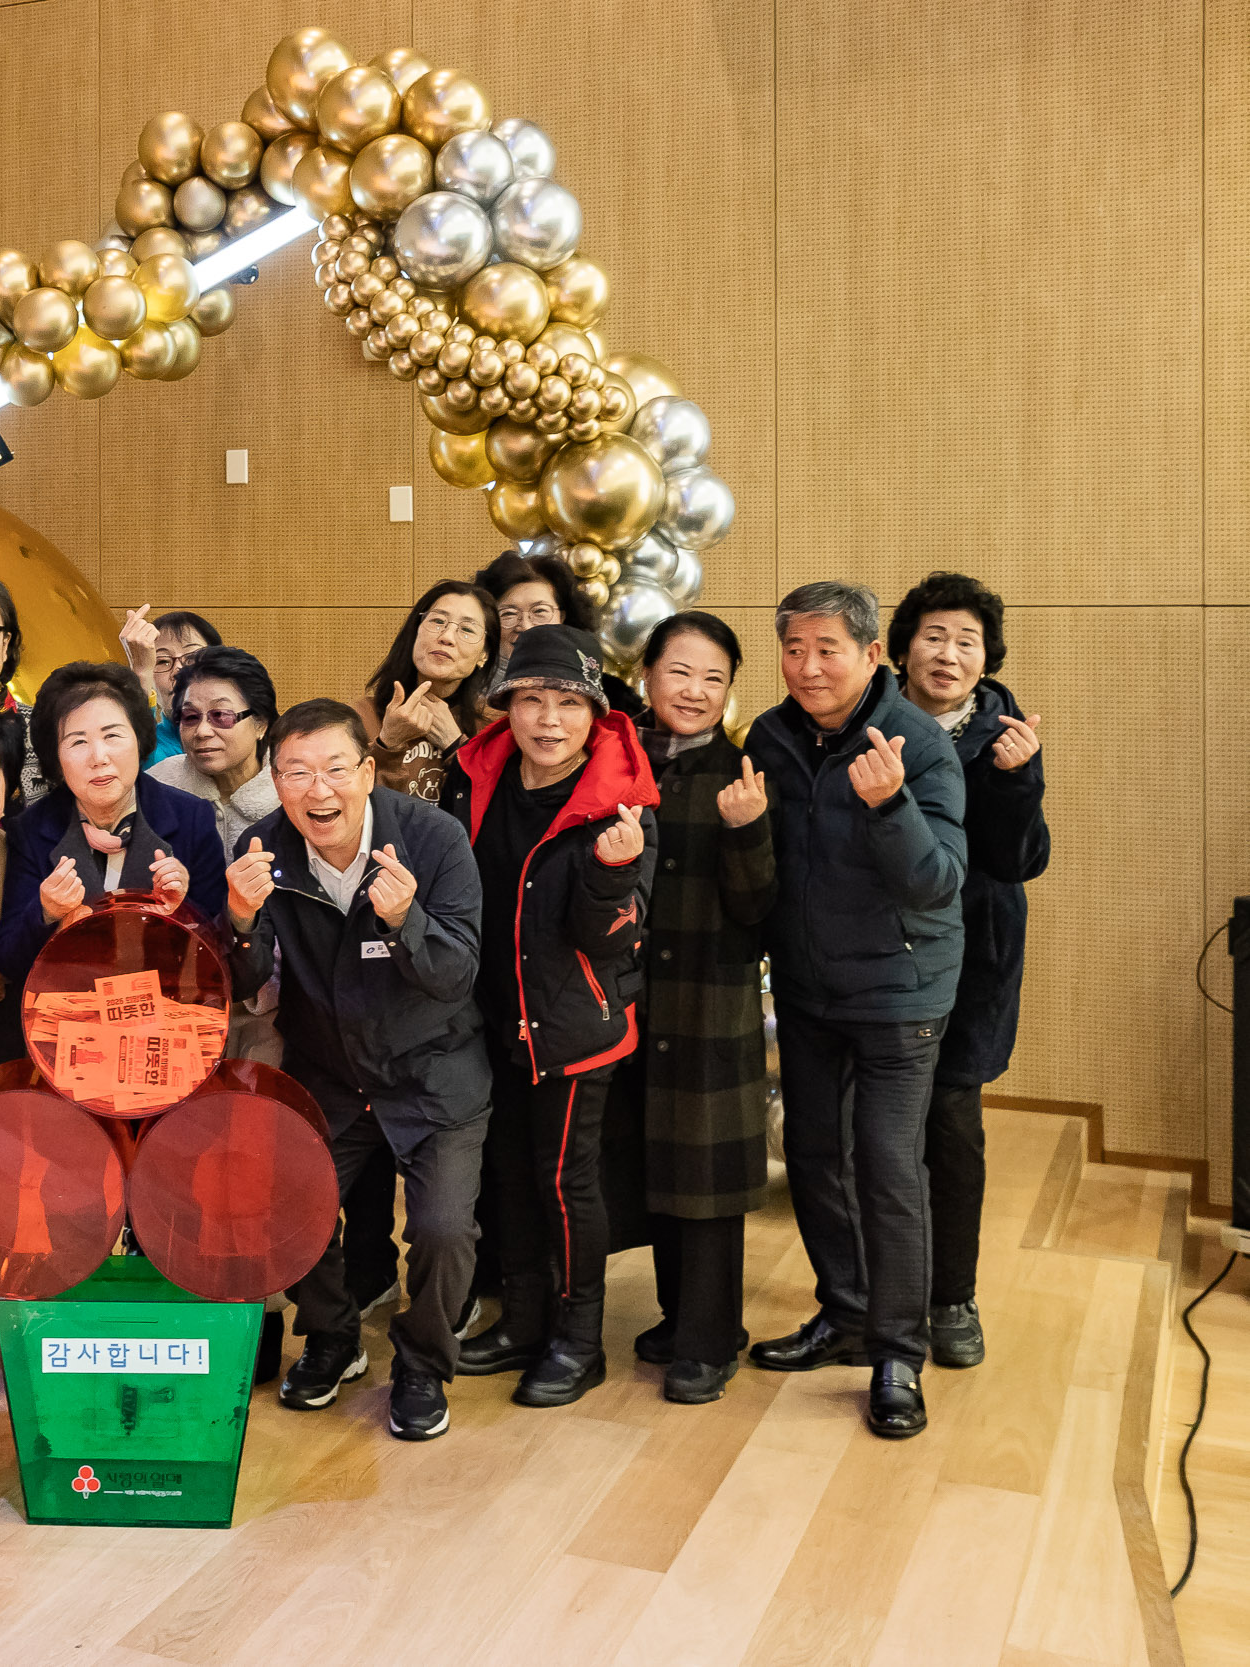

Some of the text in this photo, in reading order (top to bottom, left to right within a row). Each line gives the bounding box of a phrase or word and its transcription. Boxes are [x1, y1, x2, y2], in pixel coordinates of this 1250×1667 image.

[107, 1001, 155, 1021] 따뜻한
[145, 1036, 160, 1085] 따뜻한
[47, 1342, 203, 1368] 감사합니다!
